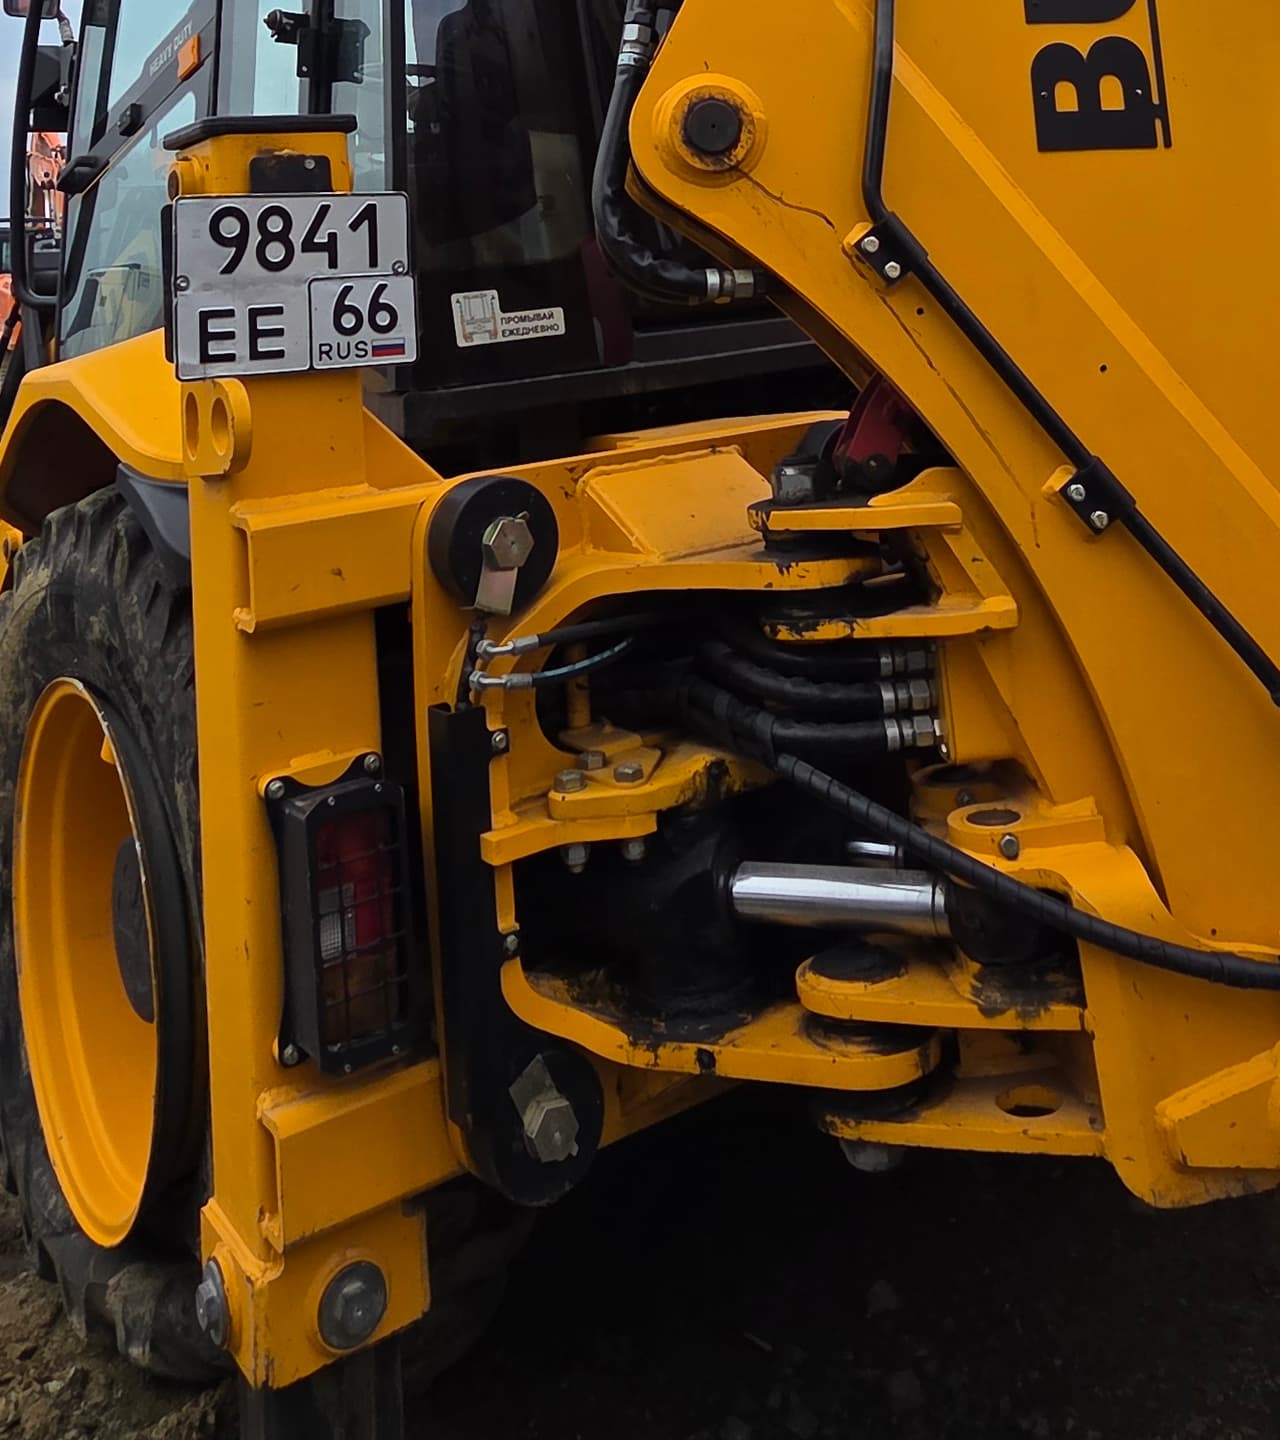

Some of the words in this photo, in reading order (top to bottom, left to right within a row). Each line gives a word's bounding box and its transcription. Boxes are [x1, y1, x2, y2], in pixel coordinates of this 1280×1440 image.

[209, 202, 380, 275] 9841
[332, 283, 399, 337] 66
[501, 311, 555, 326] ПРОМЫВАЙ
[199, 305, 286, 365] EE
[501, 323, 560, 338] ЕЖЕДНЕВНО
[318, 340, 369, 361] RUS
